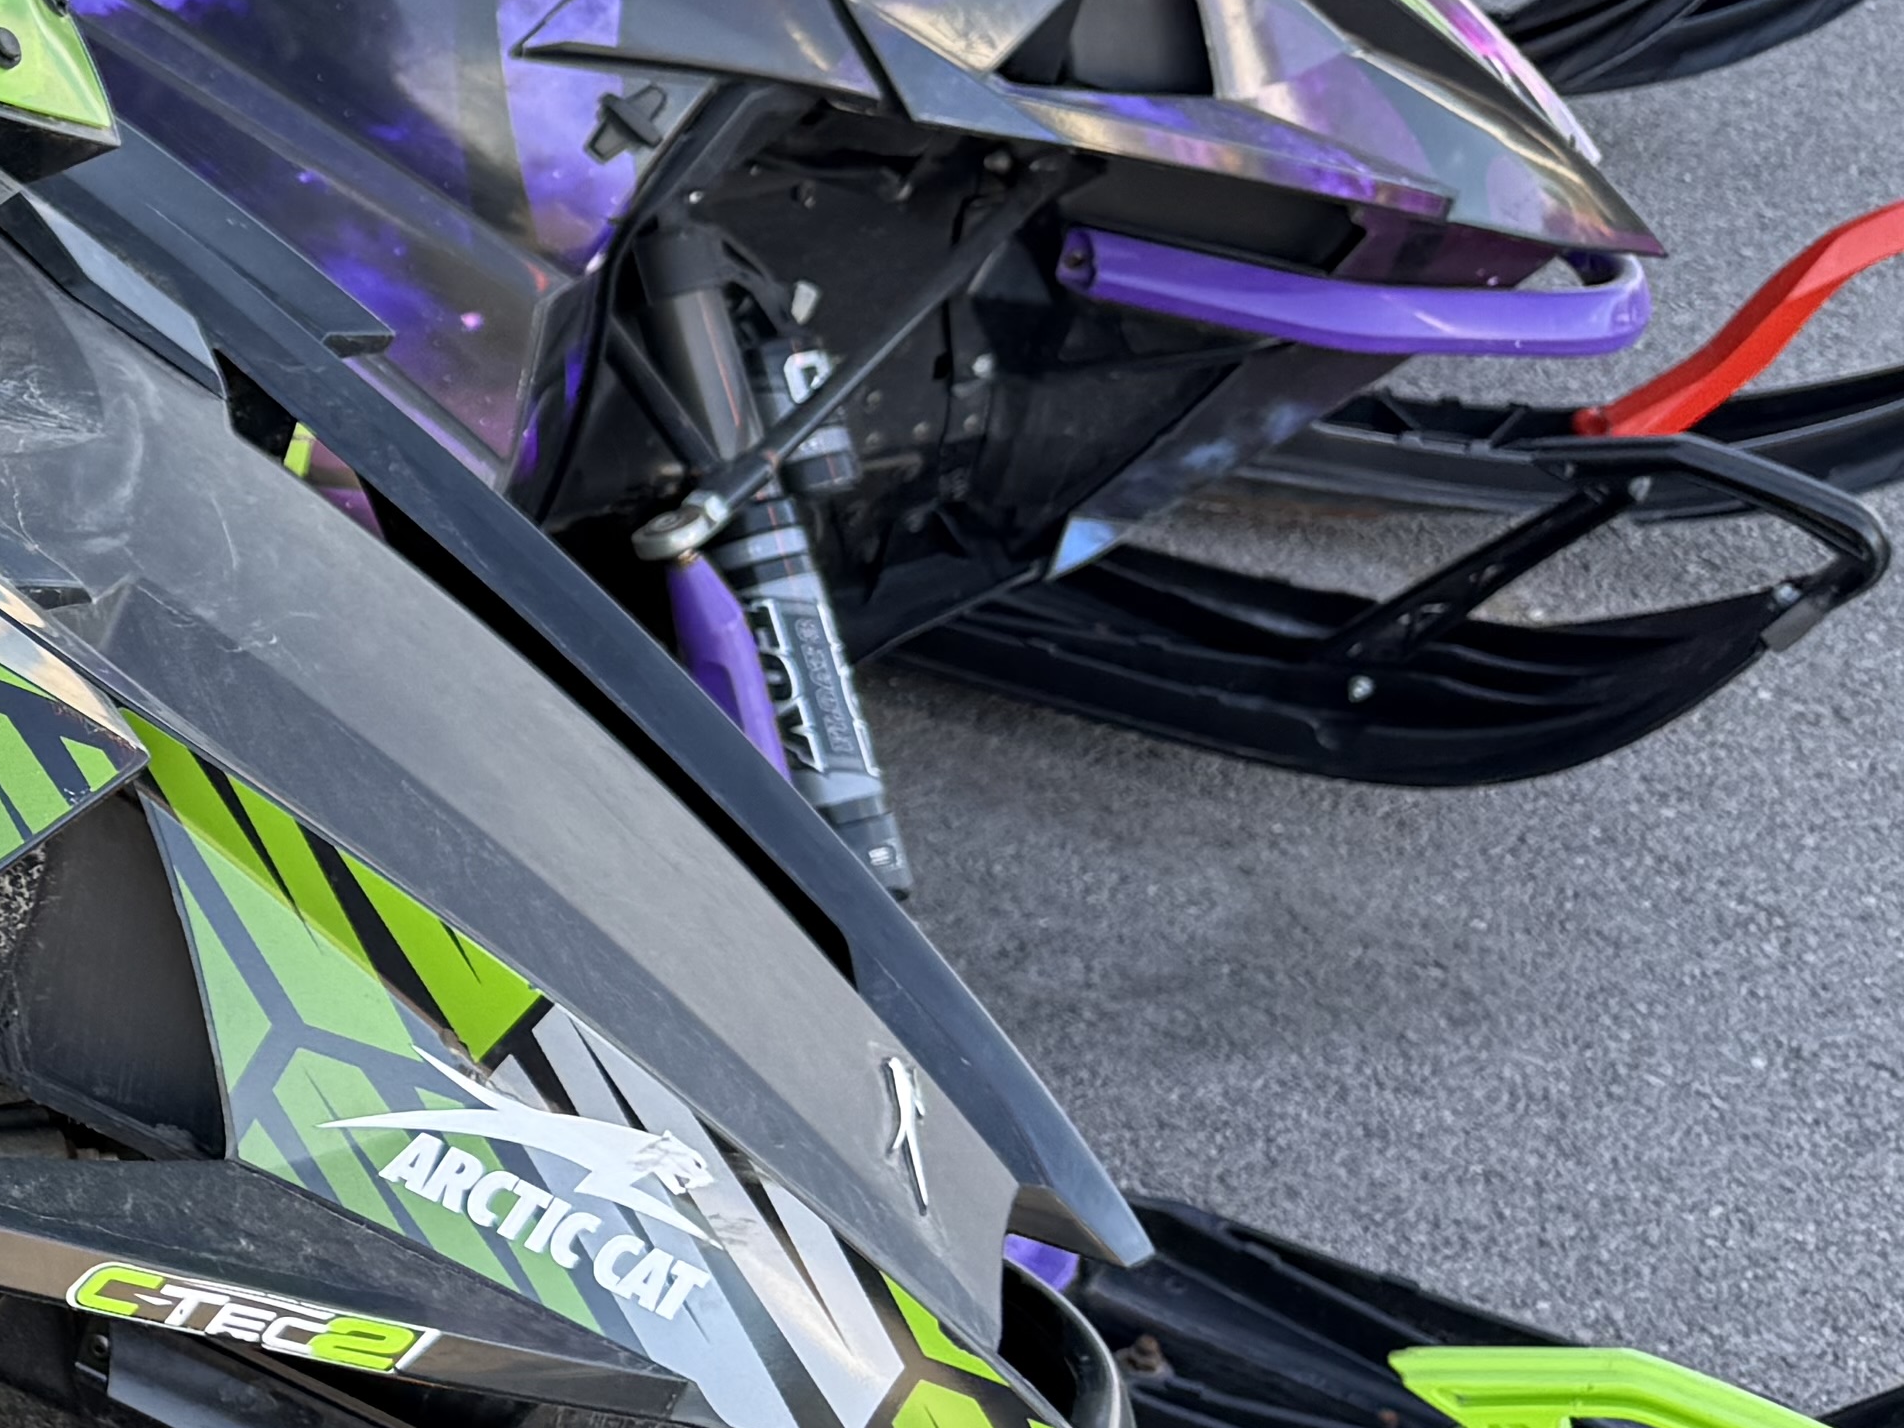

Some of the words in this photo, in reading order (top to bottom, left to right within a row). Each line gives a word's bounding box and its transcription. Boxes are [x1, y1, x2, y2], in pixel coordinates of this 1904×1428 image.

[379, 1131, 602, 1270] ARCTIC
[592, 1232, 711, 1321] CAT
[69, 1262, 420, 1374] C-TEC2
